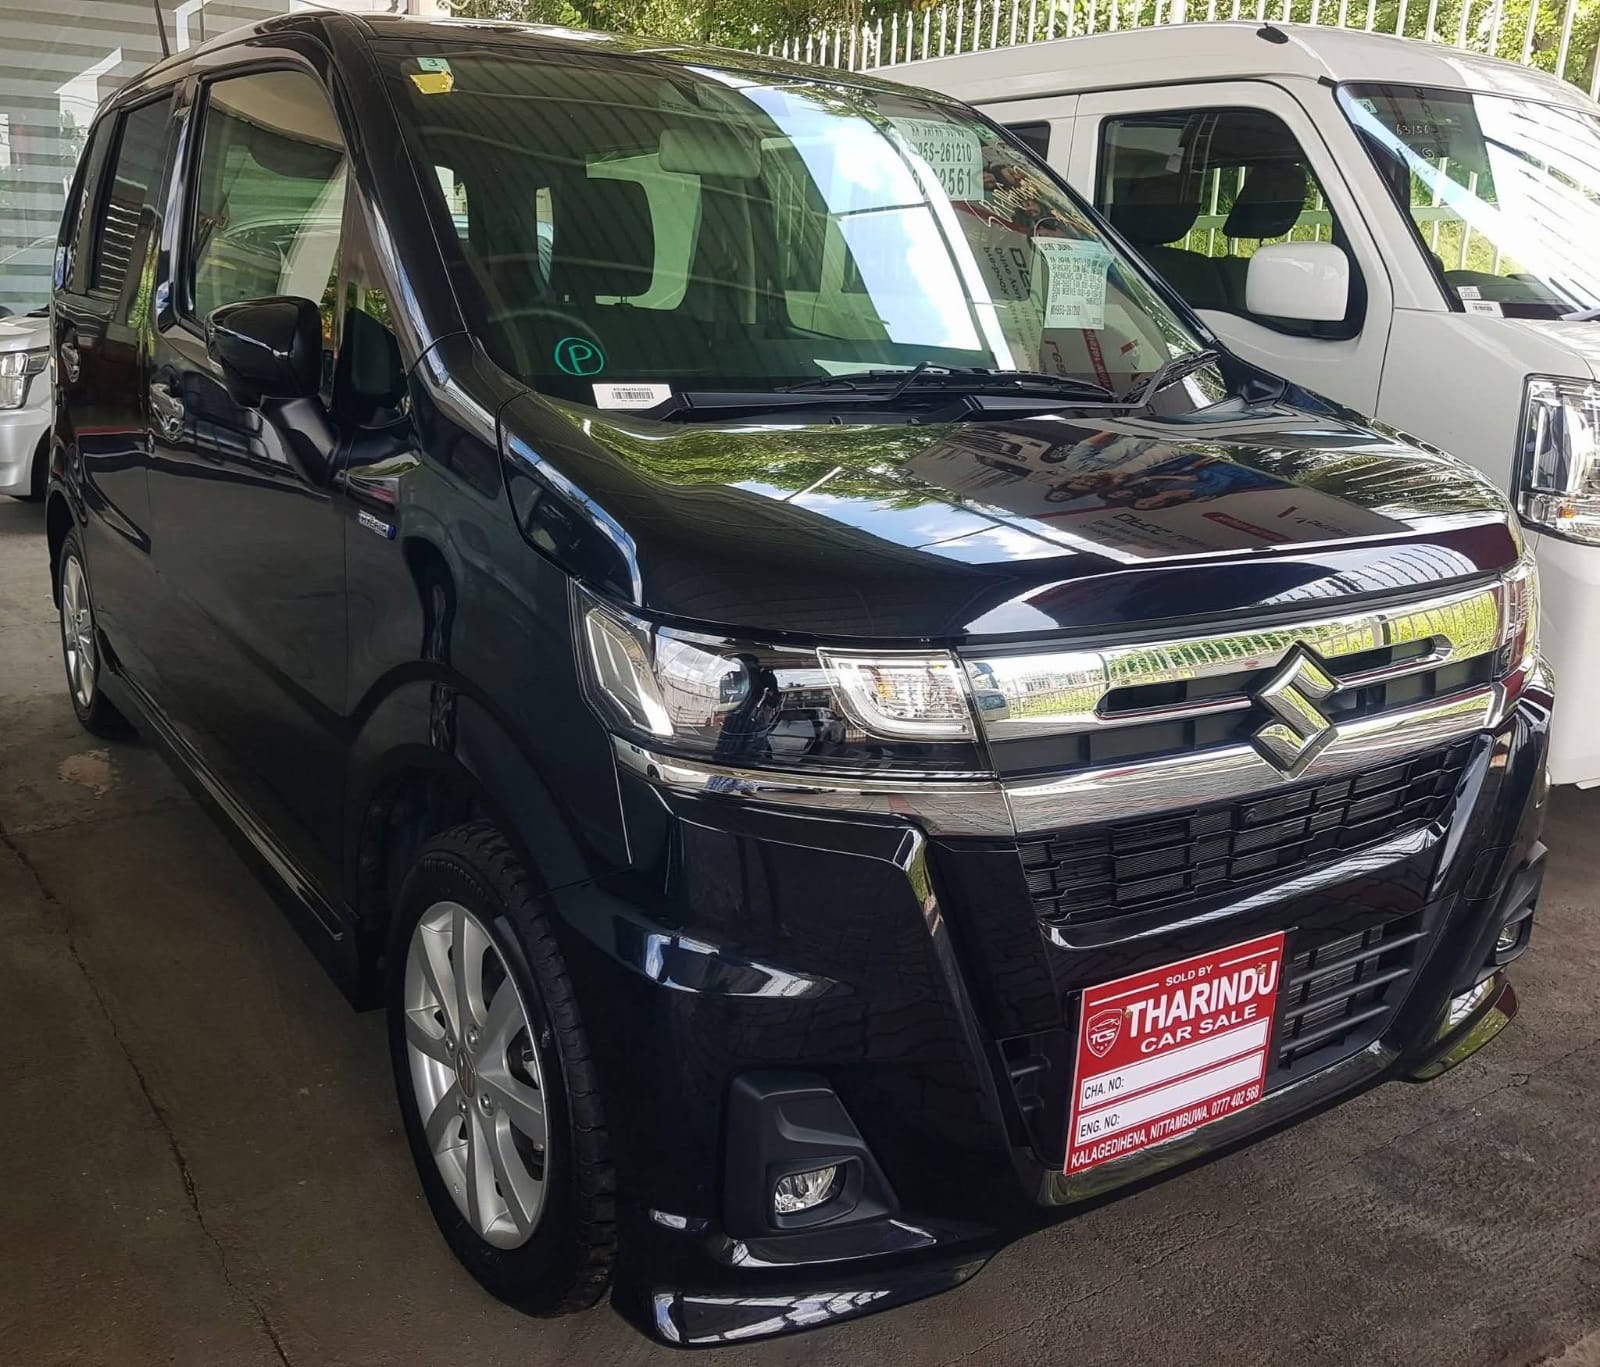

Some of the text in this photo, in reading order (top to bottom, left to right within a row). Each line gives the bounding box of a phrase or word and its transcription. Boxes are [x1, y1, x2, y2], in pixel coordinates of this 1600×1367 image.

[1165, 965, 1213, 986] SOLD BY
[1126, 960, 1278, 1038] THARINDU
[1090, 1028, 1116, 1045] TCS
[1140, 1003, 1258, 1053] CAR SALE
[1084, 1076, 1125, 1100] CHA. NO:
[1071, 1128, 1148, 1169] KALAGEDIHENA,
[1211, 1096, 1231, 1116] 0777
[1231, 1091, 1246, 1108] 402
[1080, 1113, 1121, 1137] ENG. NO:
